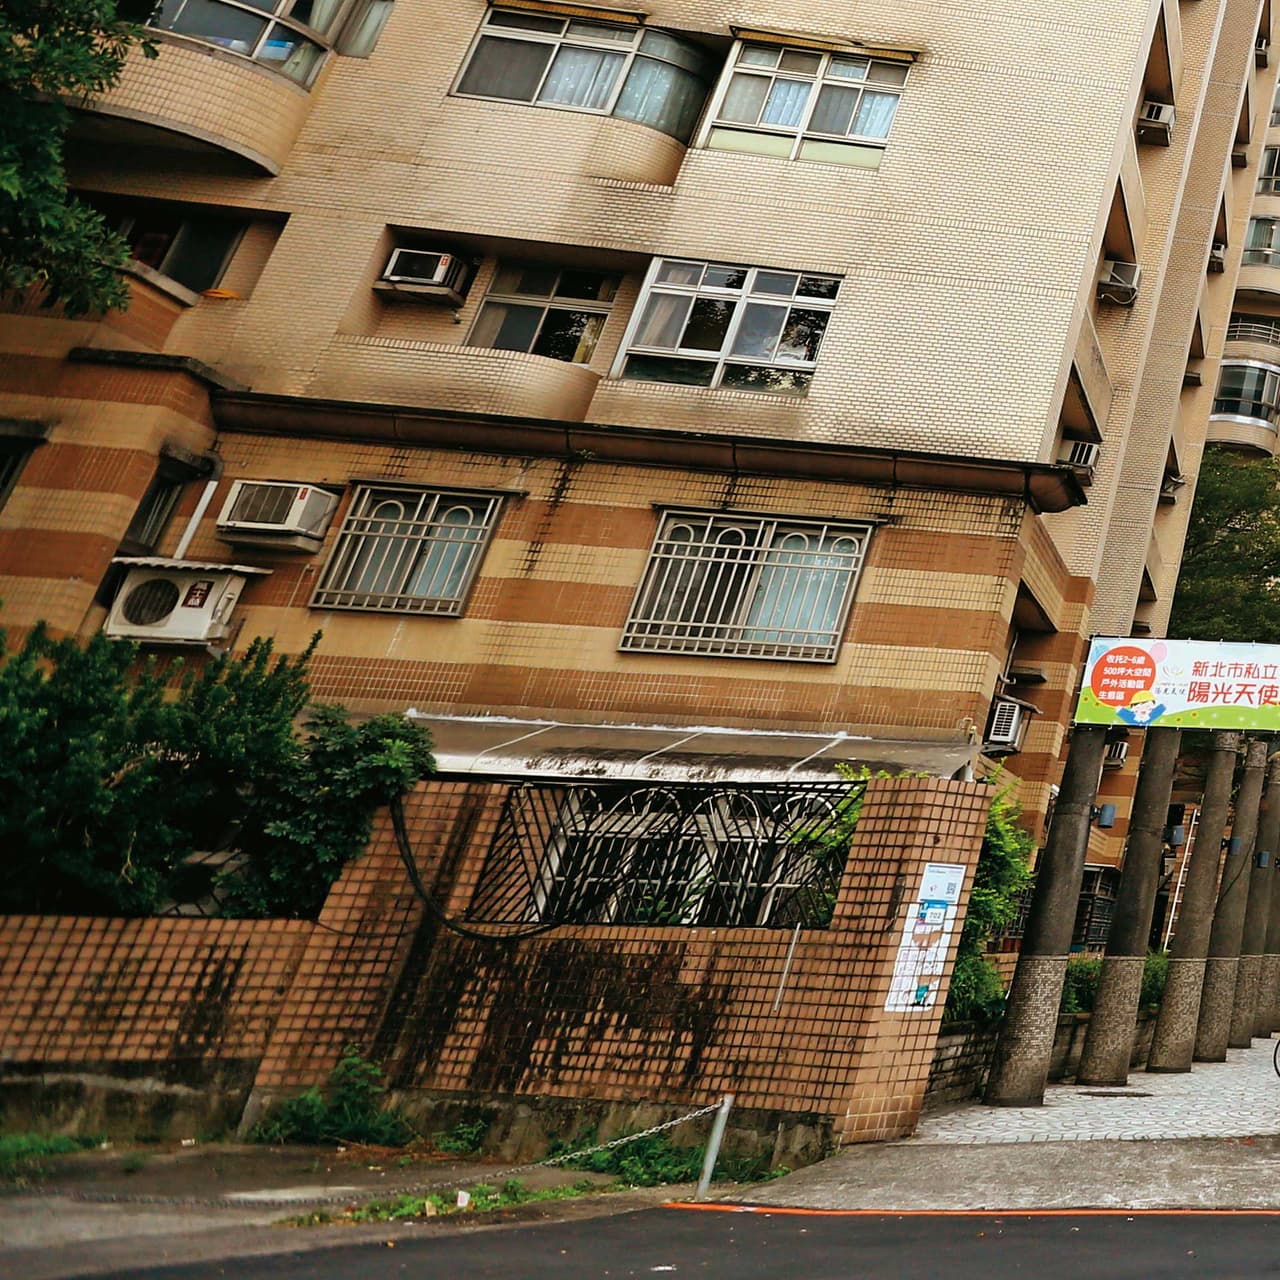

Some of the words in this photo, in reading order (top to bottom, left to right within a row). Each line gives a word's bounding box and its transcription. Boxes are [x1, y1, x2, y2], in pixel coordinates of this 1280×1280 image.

[1191, 660, 1279, 680] 新北市私立
